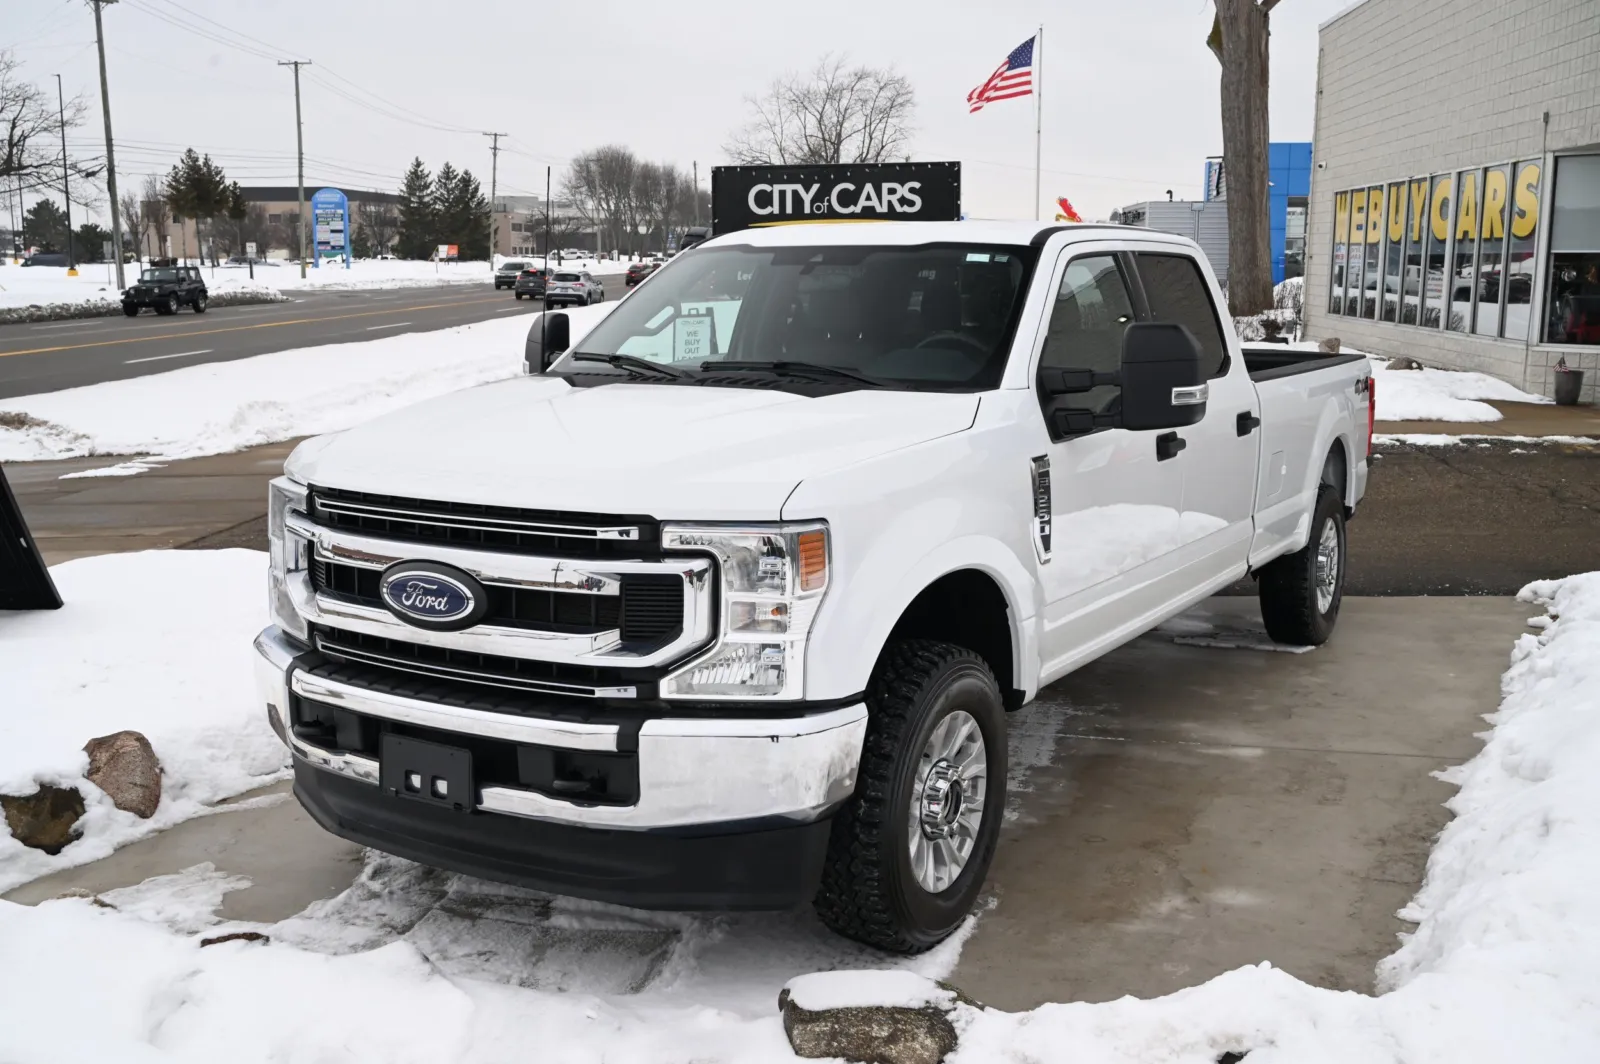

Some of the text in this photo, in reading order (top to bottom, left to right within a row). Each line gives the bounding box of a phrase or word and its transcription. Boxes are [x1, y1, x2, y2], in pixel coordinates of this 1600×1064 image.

[748, 182, 922, 215] CITY of CARS
[686, 330, 699, 338] WE
[401, 580, 449, 611] Ford
